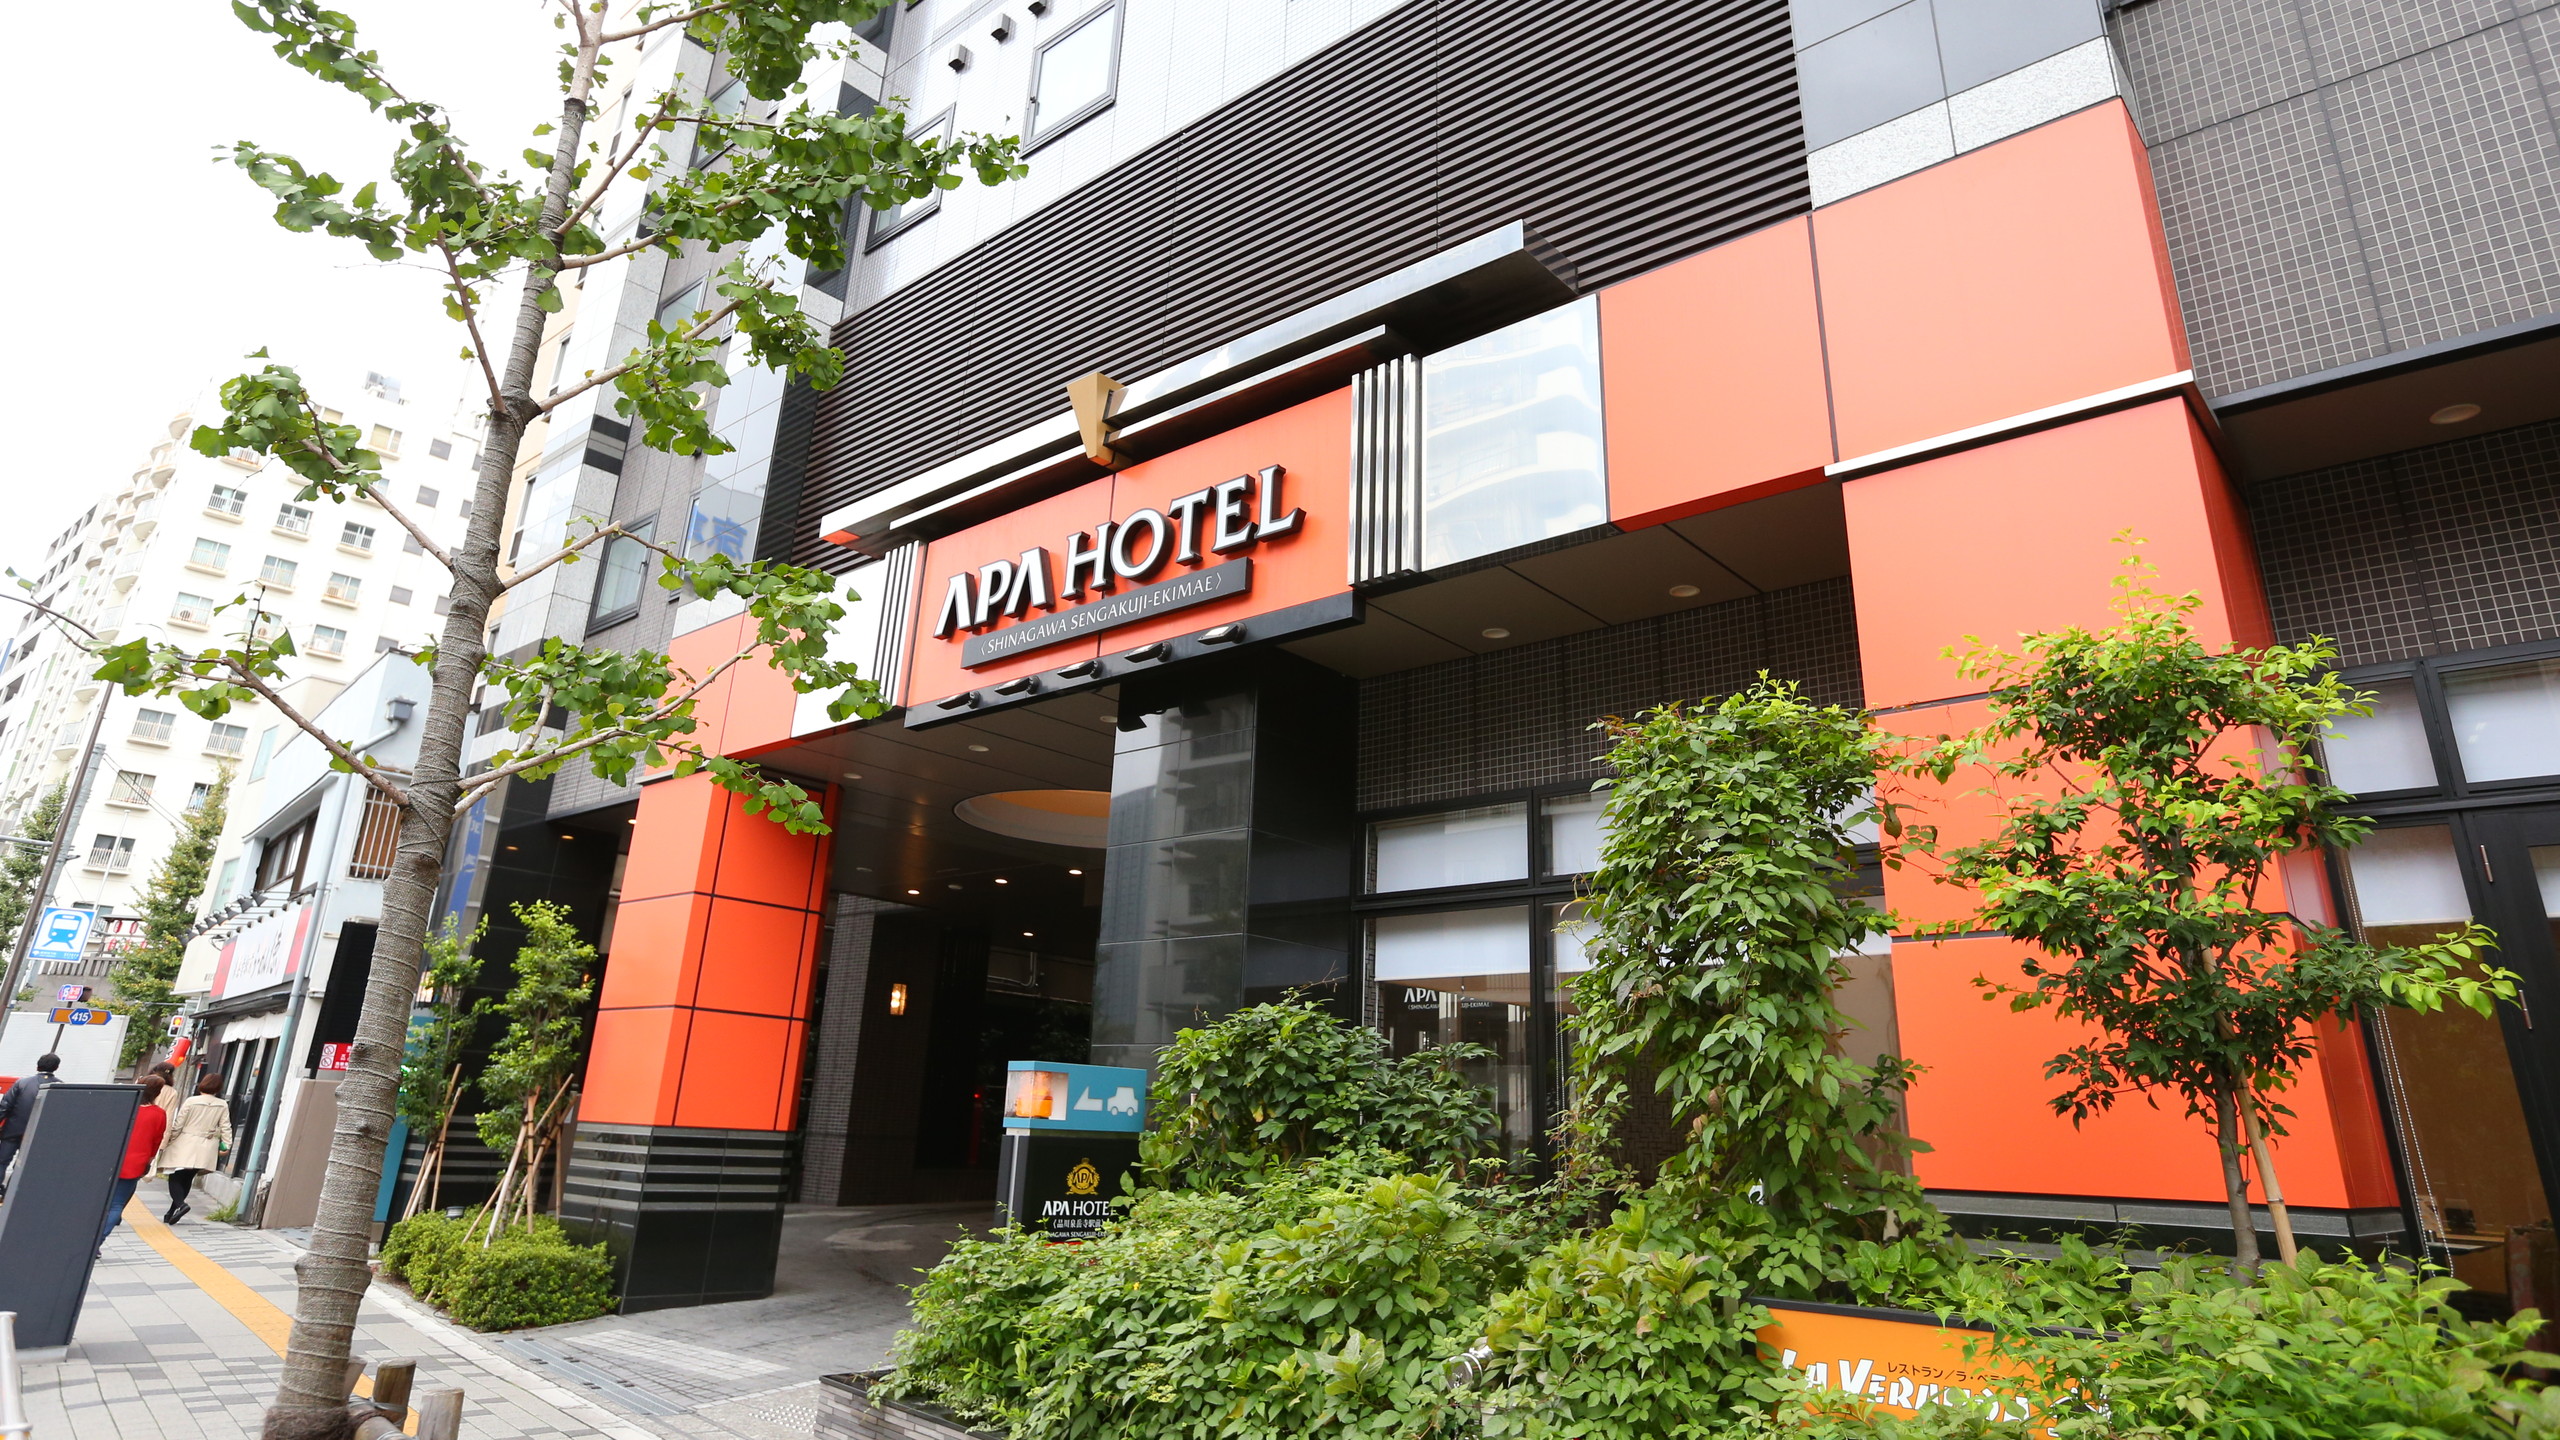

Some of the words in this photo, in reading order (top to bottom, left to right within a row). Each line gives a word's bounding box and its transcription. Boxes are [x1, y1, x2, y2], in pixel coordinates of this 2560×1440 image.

[933, 546, 1053, 639] APA
[1061, 464, 1306, 600] HOTEL
[1404, 987, 1437, 1003] APA
[71, 1012, 89, 1022] 415
[1073, 1172, 1093, 1184] APA
[1042, 1200, 1070, 1216] APA
